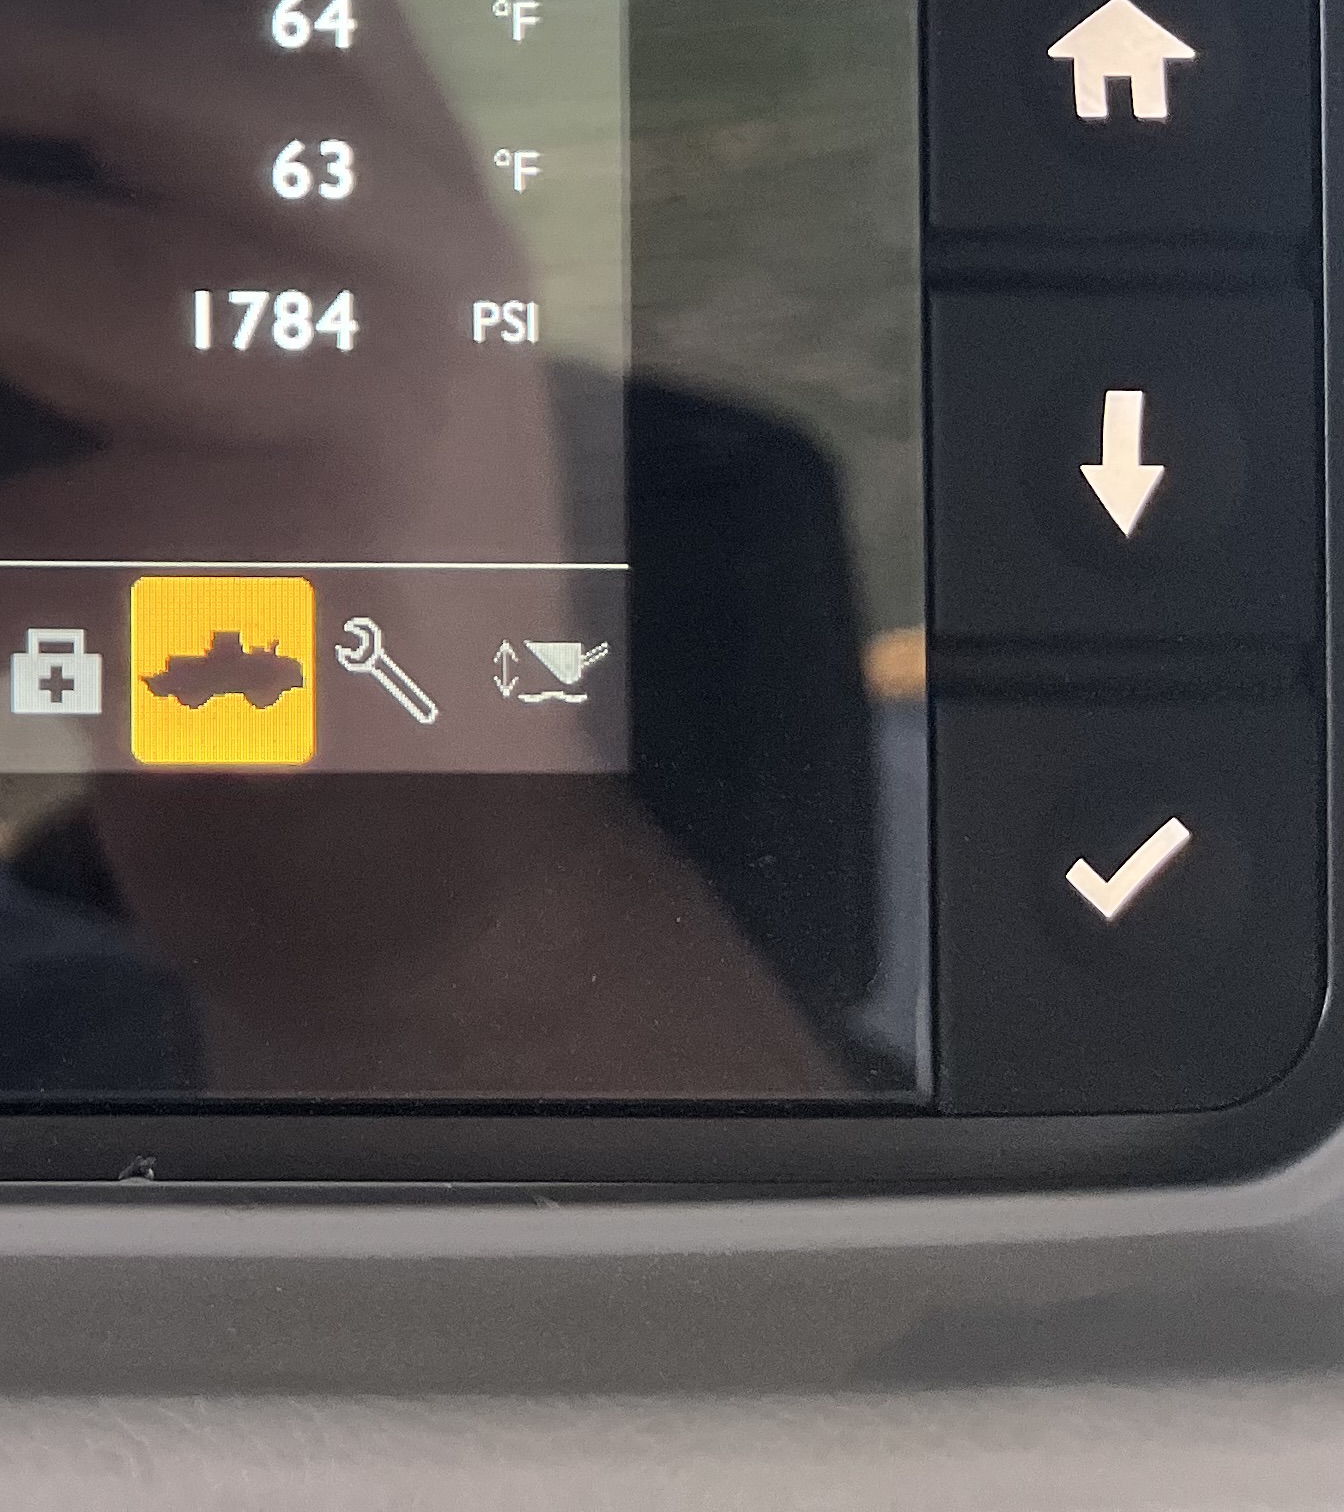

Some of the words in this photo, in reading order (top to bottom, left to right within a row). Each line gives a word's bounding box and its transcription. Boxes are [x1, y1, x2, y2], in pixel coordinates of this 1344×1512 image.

[271, 139, 355, 200] 63
[493, 149, 541, 193] °F
[192, 290, 359, 352] 1784
[472, 300, 540, 345] PSI
